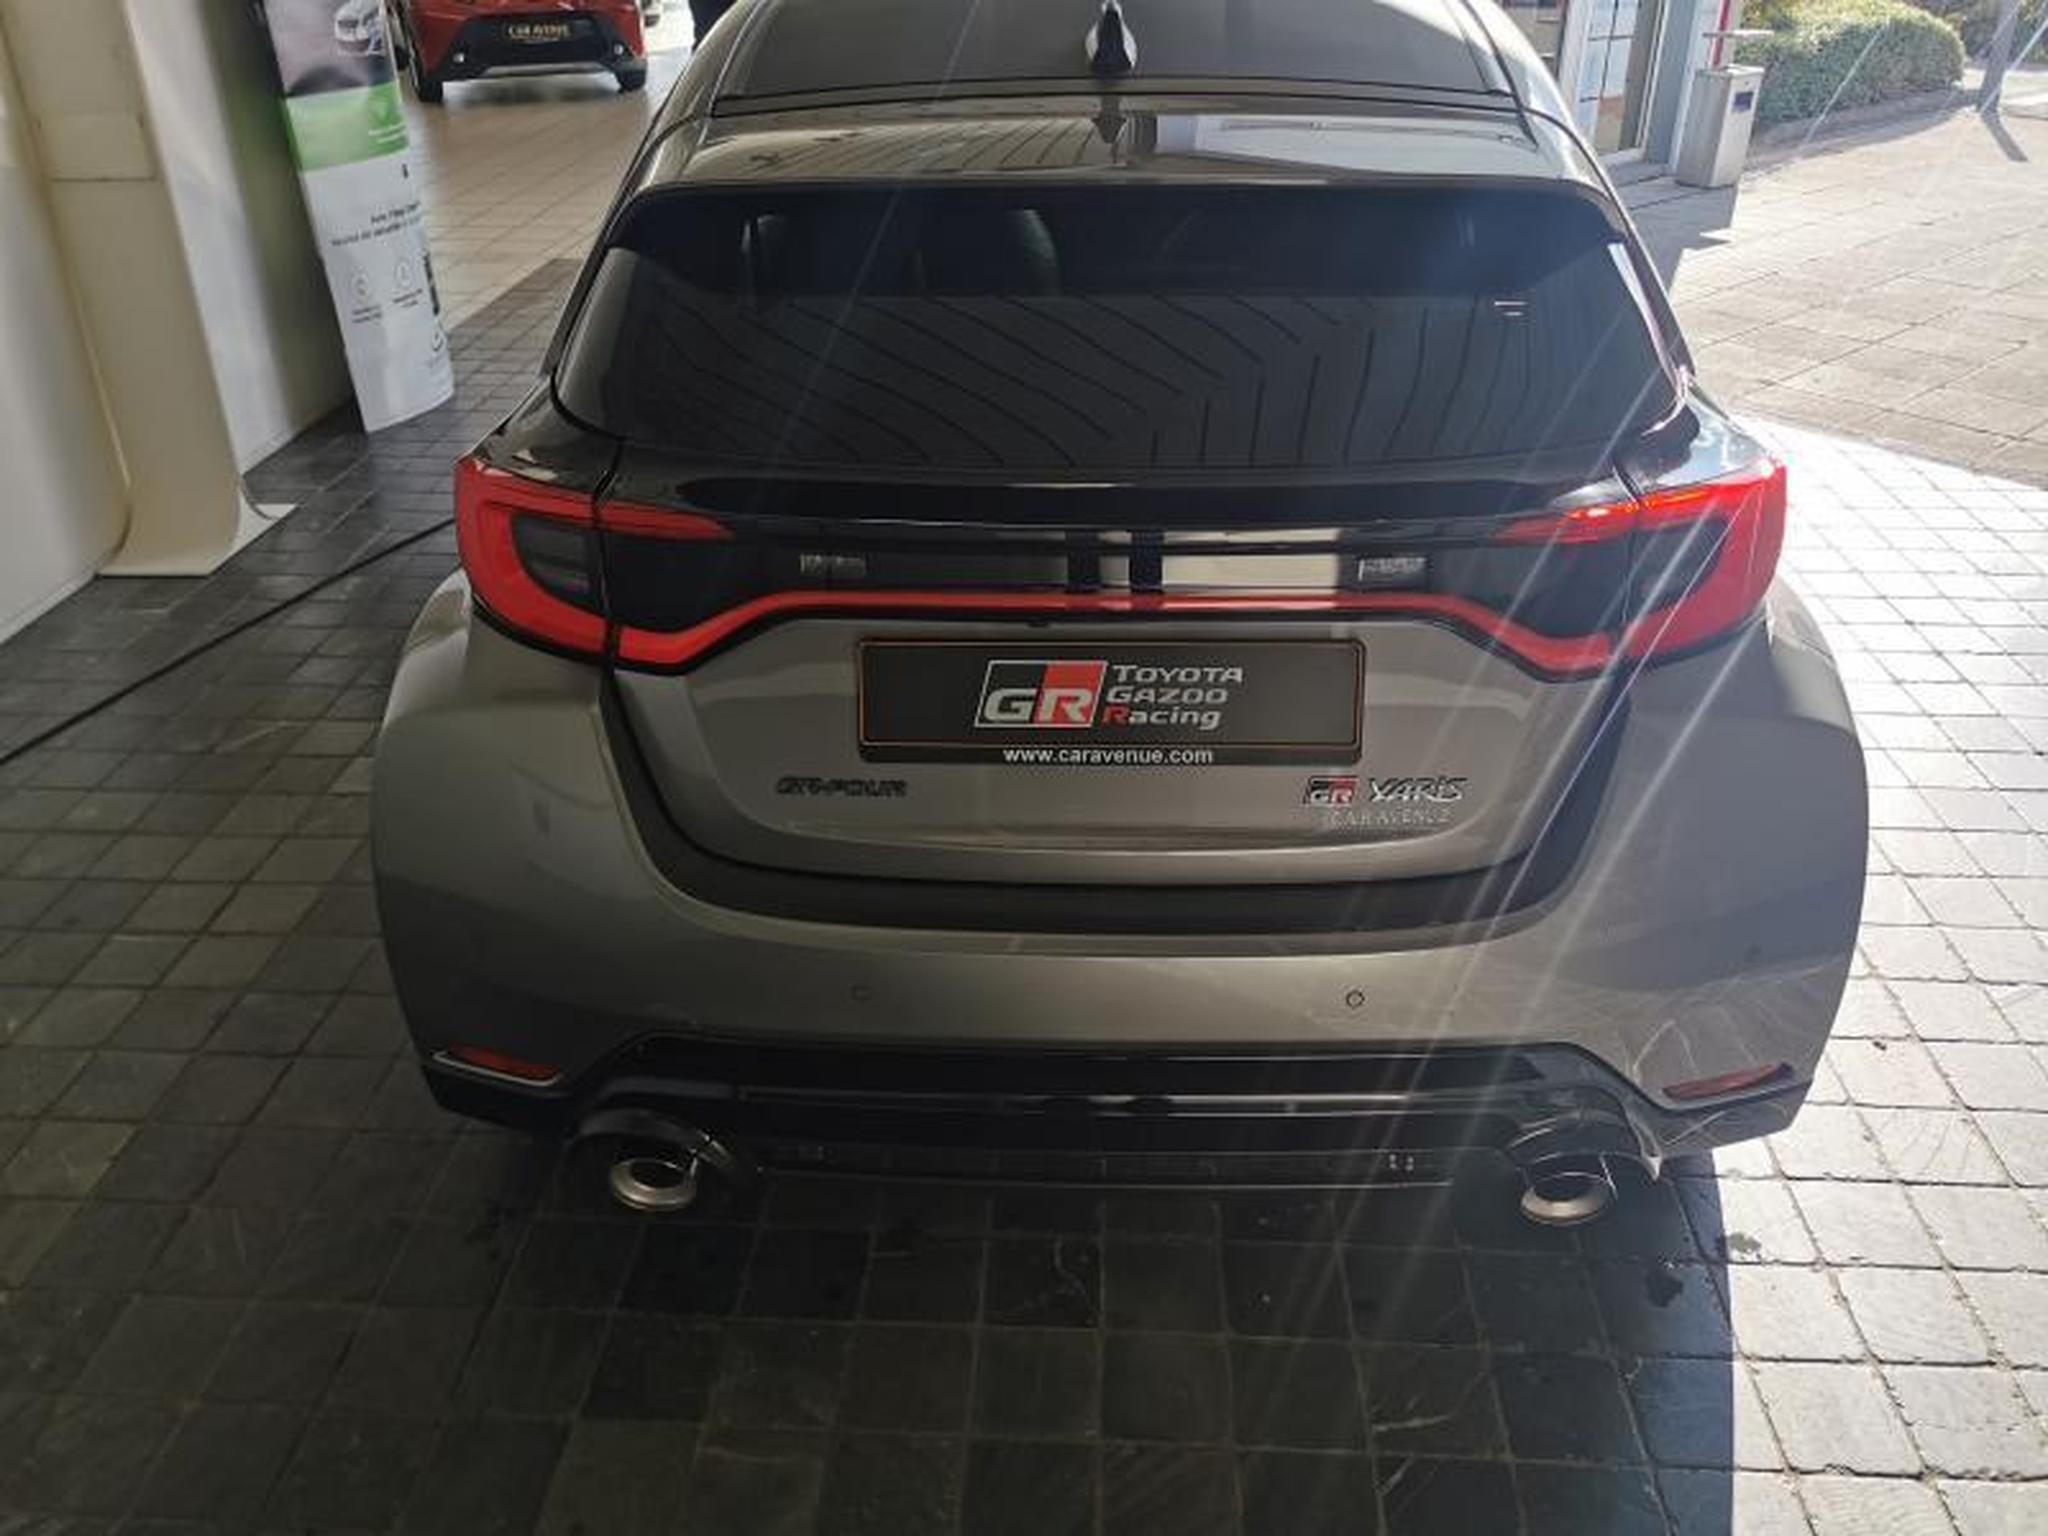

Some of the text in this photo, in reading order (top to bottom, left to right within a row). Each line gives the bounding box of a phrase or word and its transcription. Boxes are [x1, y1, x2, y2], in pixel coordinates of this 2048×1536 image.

[1112, 665, 1243, 682] TOYOTA
[1105, 686, 1228, 703] GAZOO
[983, 687, 1092, 722] GR
[1102, 706, 1221, 730] Racing
[1003, 749, 1213, 764] www.caravenue.com
